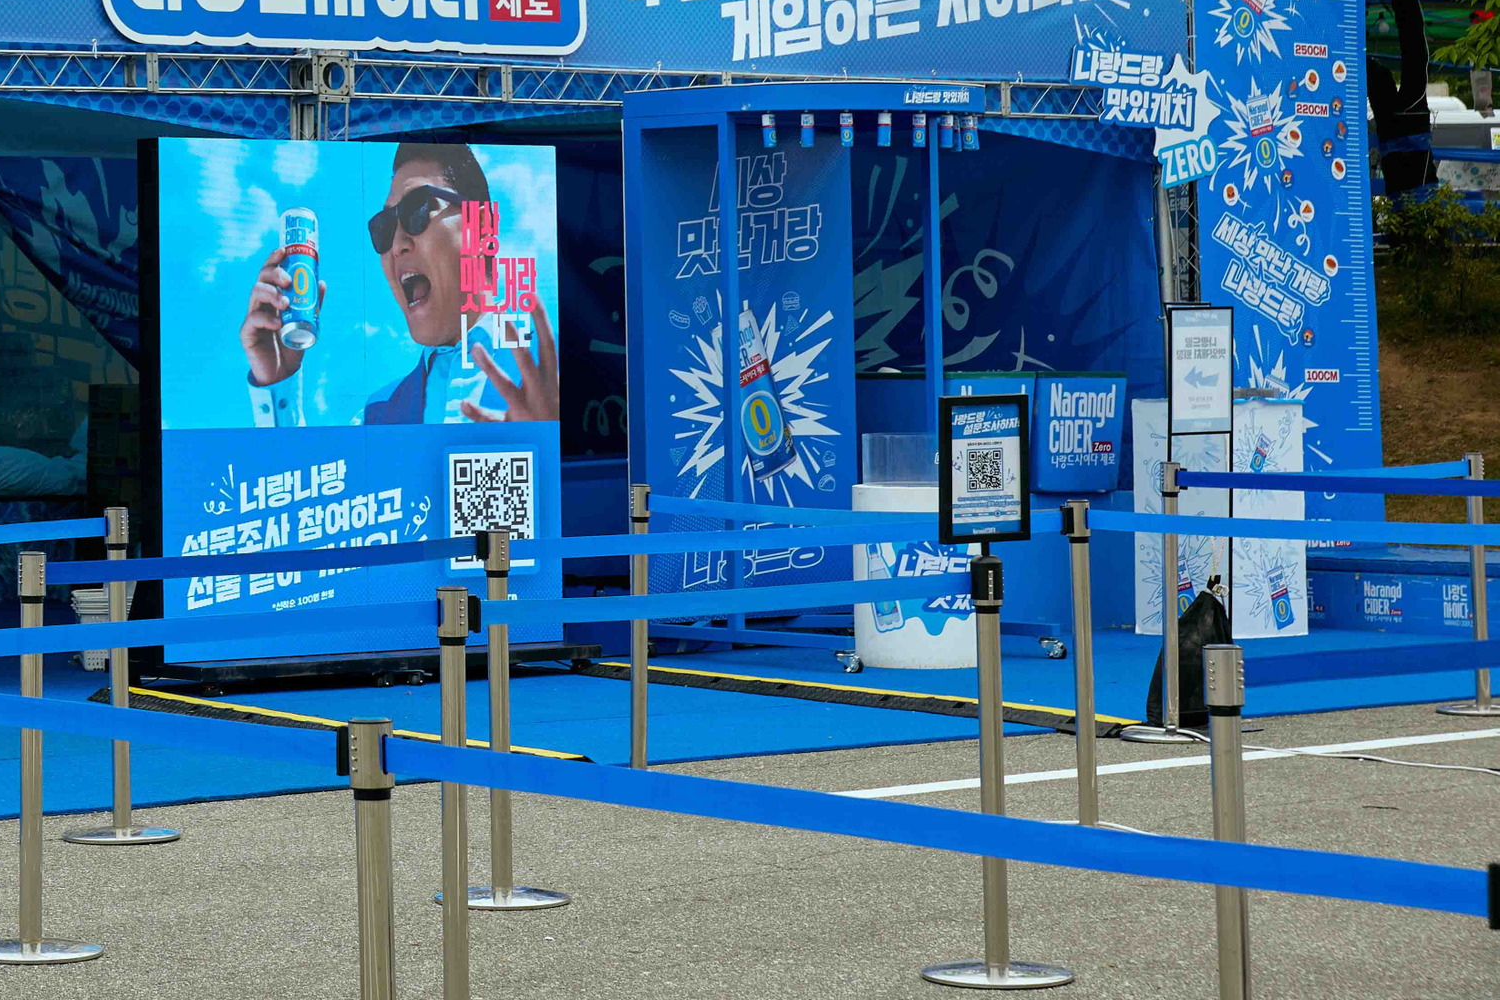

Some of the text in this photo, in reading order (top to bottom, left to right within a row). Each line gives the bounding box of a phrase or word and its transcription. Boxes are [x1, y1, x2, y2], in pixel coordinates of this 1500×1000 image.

[1295, 45, 1327, 57] 250CM
[1074, 49, 1164, 87] 나랑드랑
[905, 91, 941, 104] 나랑드랑
[1105, 88, 1195, 128] 맛있캐치
[1296, 104, 1328, 116] 220CM
[1161, 140, 1216, 185] ZERO
[1261, 141, 1270, 158] 0
[460, 201, 499, 256] 세상
[1215, 217, 1329, 302] 세상 맛난 거랑
[293, 268, 308, 294] 0
[1223, 262, 1303, 330] 나랑드랑
[1306, 370, 1338, 381] 100CM
[751, 399, 771, 435] 0
[1051, 382, 1116, 428] Narangd
[1051, 453, 1116, 469] 나랑드사이다 제로
[1094, 442, 1112, 451] Zero
[239, 459, 346, 514] 너랑나랑
[297, 487, 403, 541] 참여하고
[1364, 581, 1402, 602] Narangd
[1443, 584, 1467, 601] 나랑드
